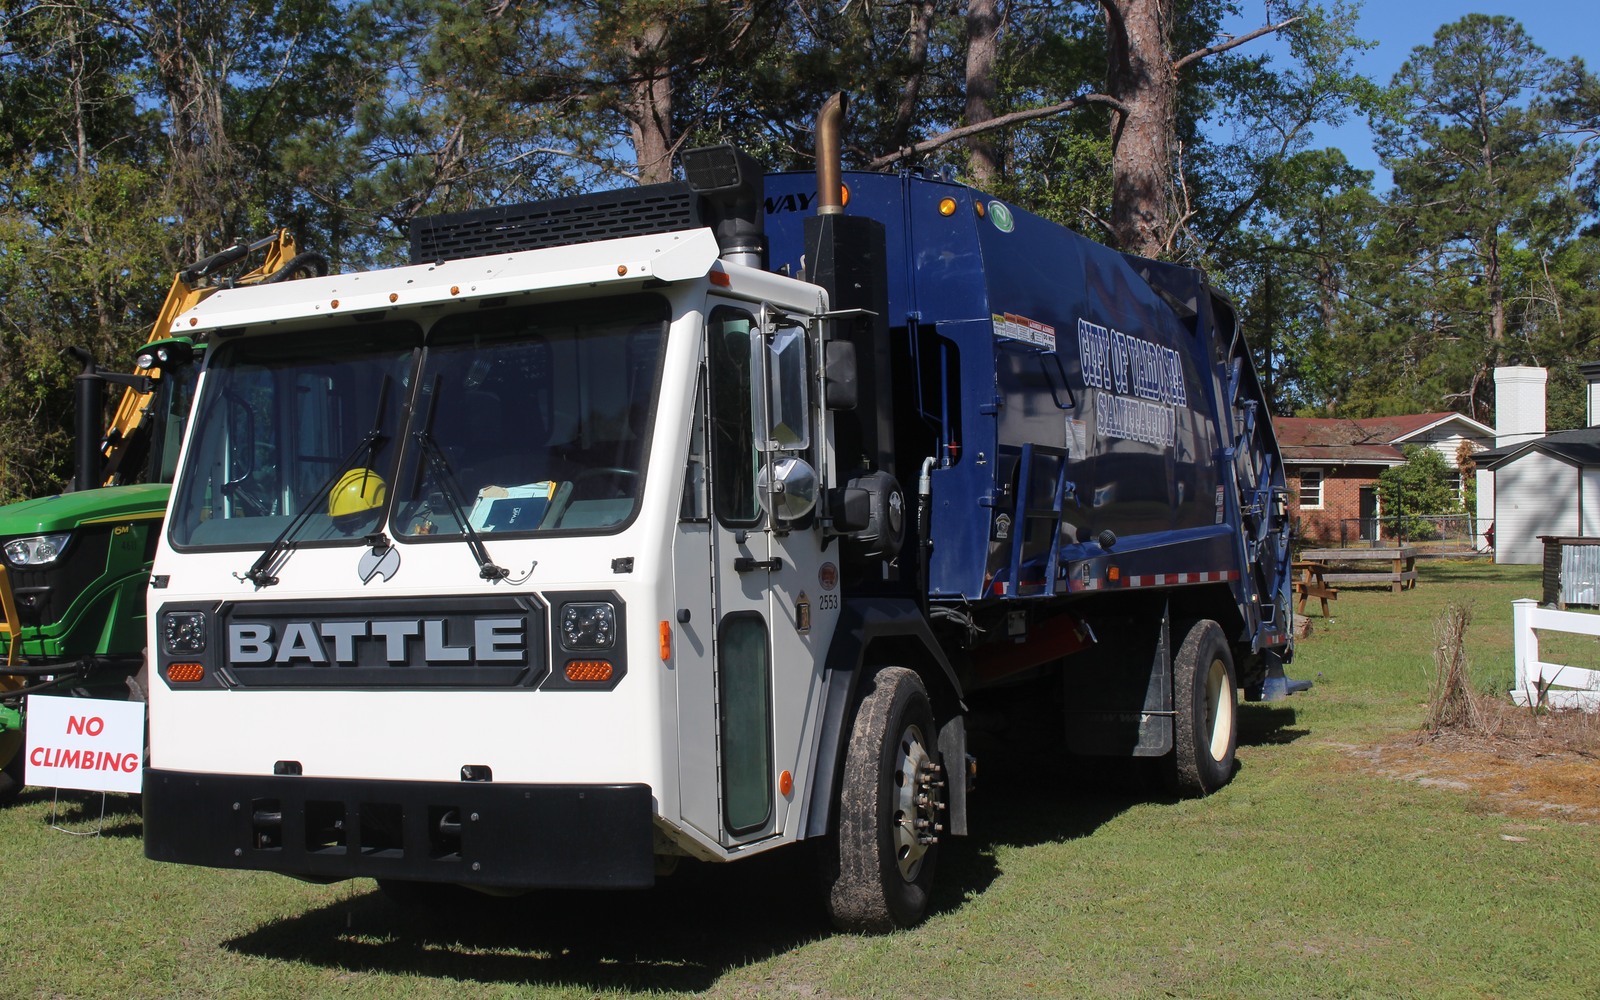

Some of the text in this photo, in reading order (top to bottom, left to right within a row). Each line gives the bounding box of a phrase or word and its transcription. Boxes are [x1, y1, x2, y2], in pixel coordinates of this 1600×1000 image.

[1078, 317, 1187, 408] CITY OF VALDOSTA
[1096, 391, 1176, 447] SANITATION
[114, 526, 129, 535] 6M
[819, 595, 837, 610] 2553
[228, 618, 525, 663] BATTLE
[66, 716, 104, 737] NO
[29, 747, 139, 773] CLIMBING
